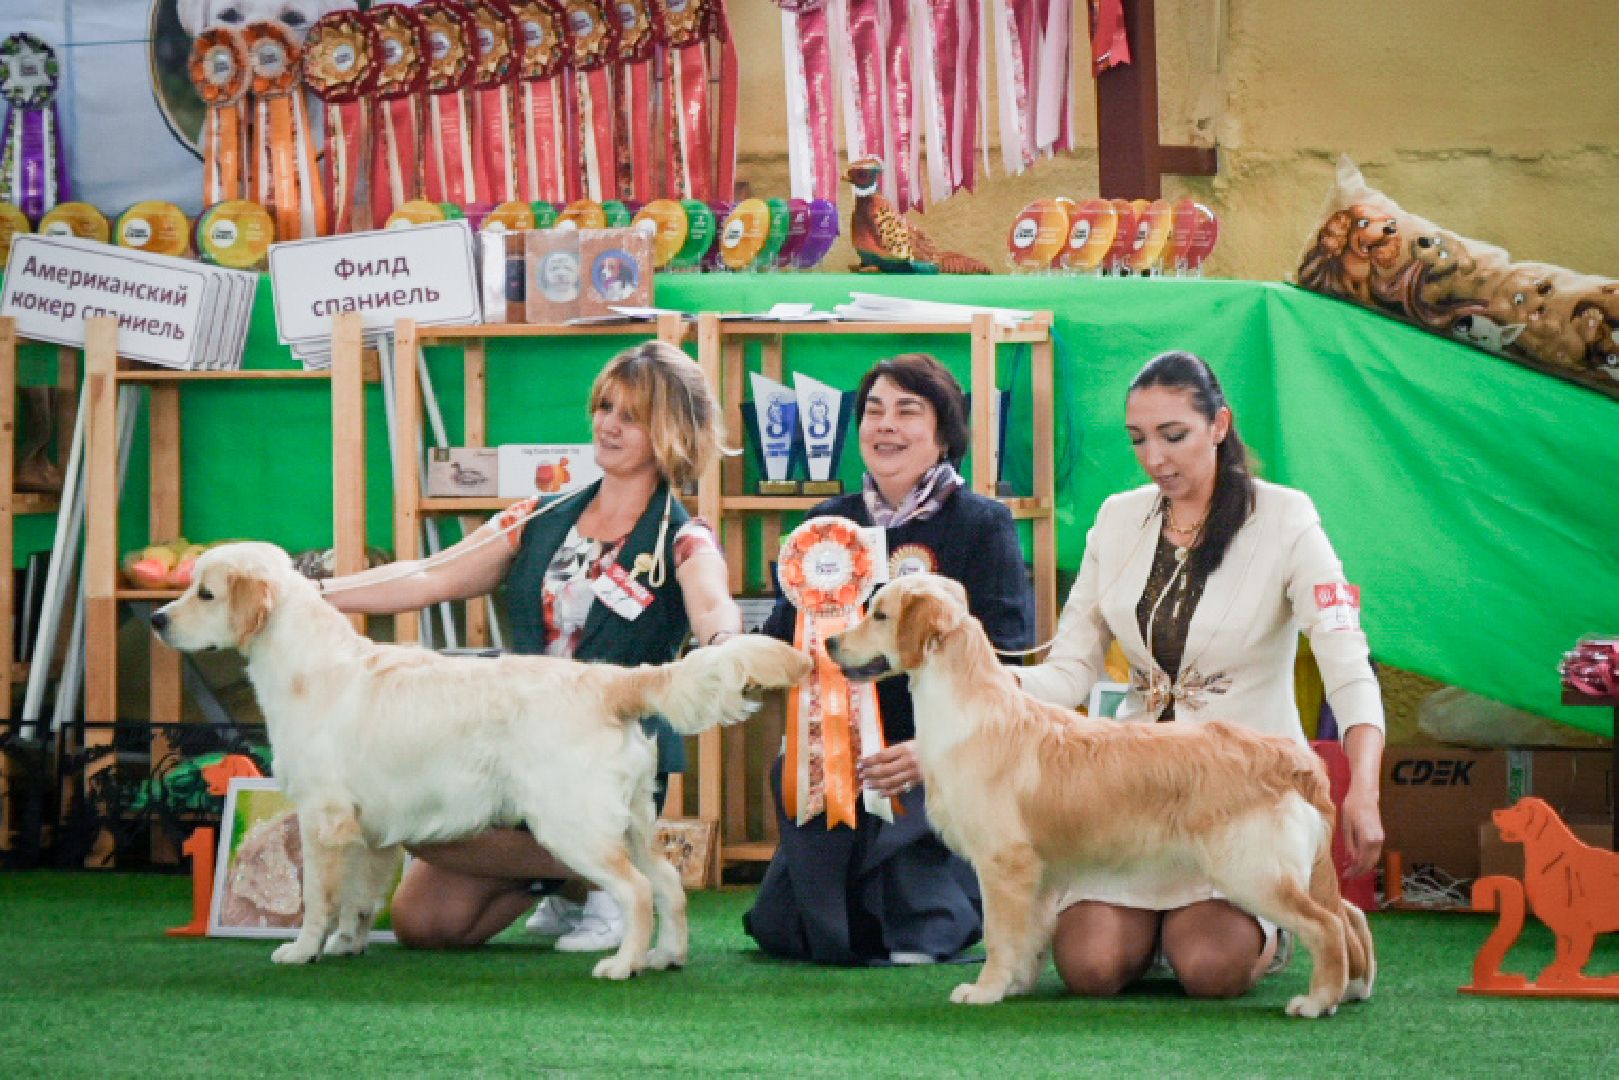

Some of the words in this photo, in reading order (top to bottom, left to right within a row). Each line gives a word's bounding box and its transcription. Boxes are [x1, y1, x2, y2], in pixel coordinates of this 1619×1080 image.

[22, 254, 189, 308] Американский
[334, 256, 410, 281] Филд
[11, 291, 77, 323] кокер
[311, 286, 440, 317] спаниель
[1391, 759, 1476, 786] CDEK
[1472, 875, 1528, 989] 2
